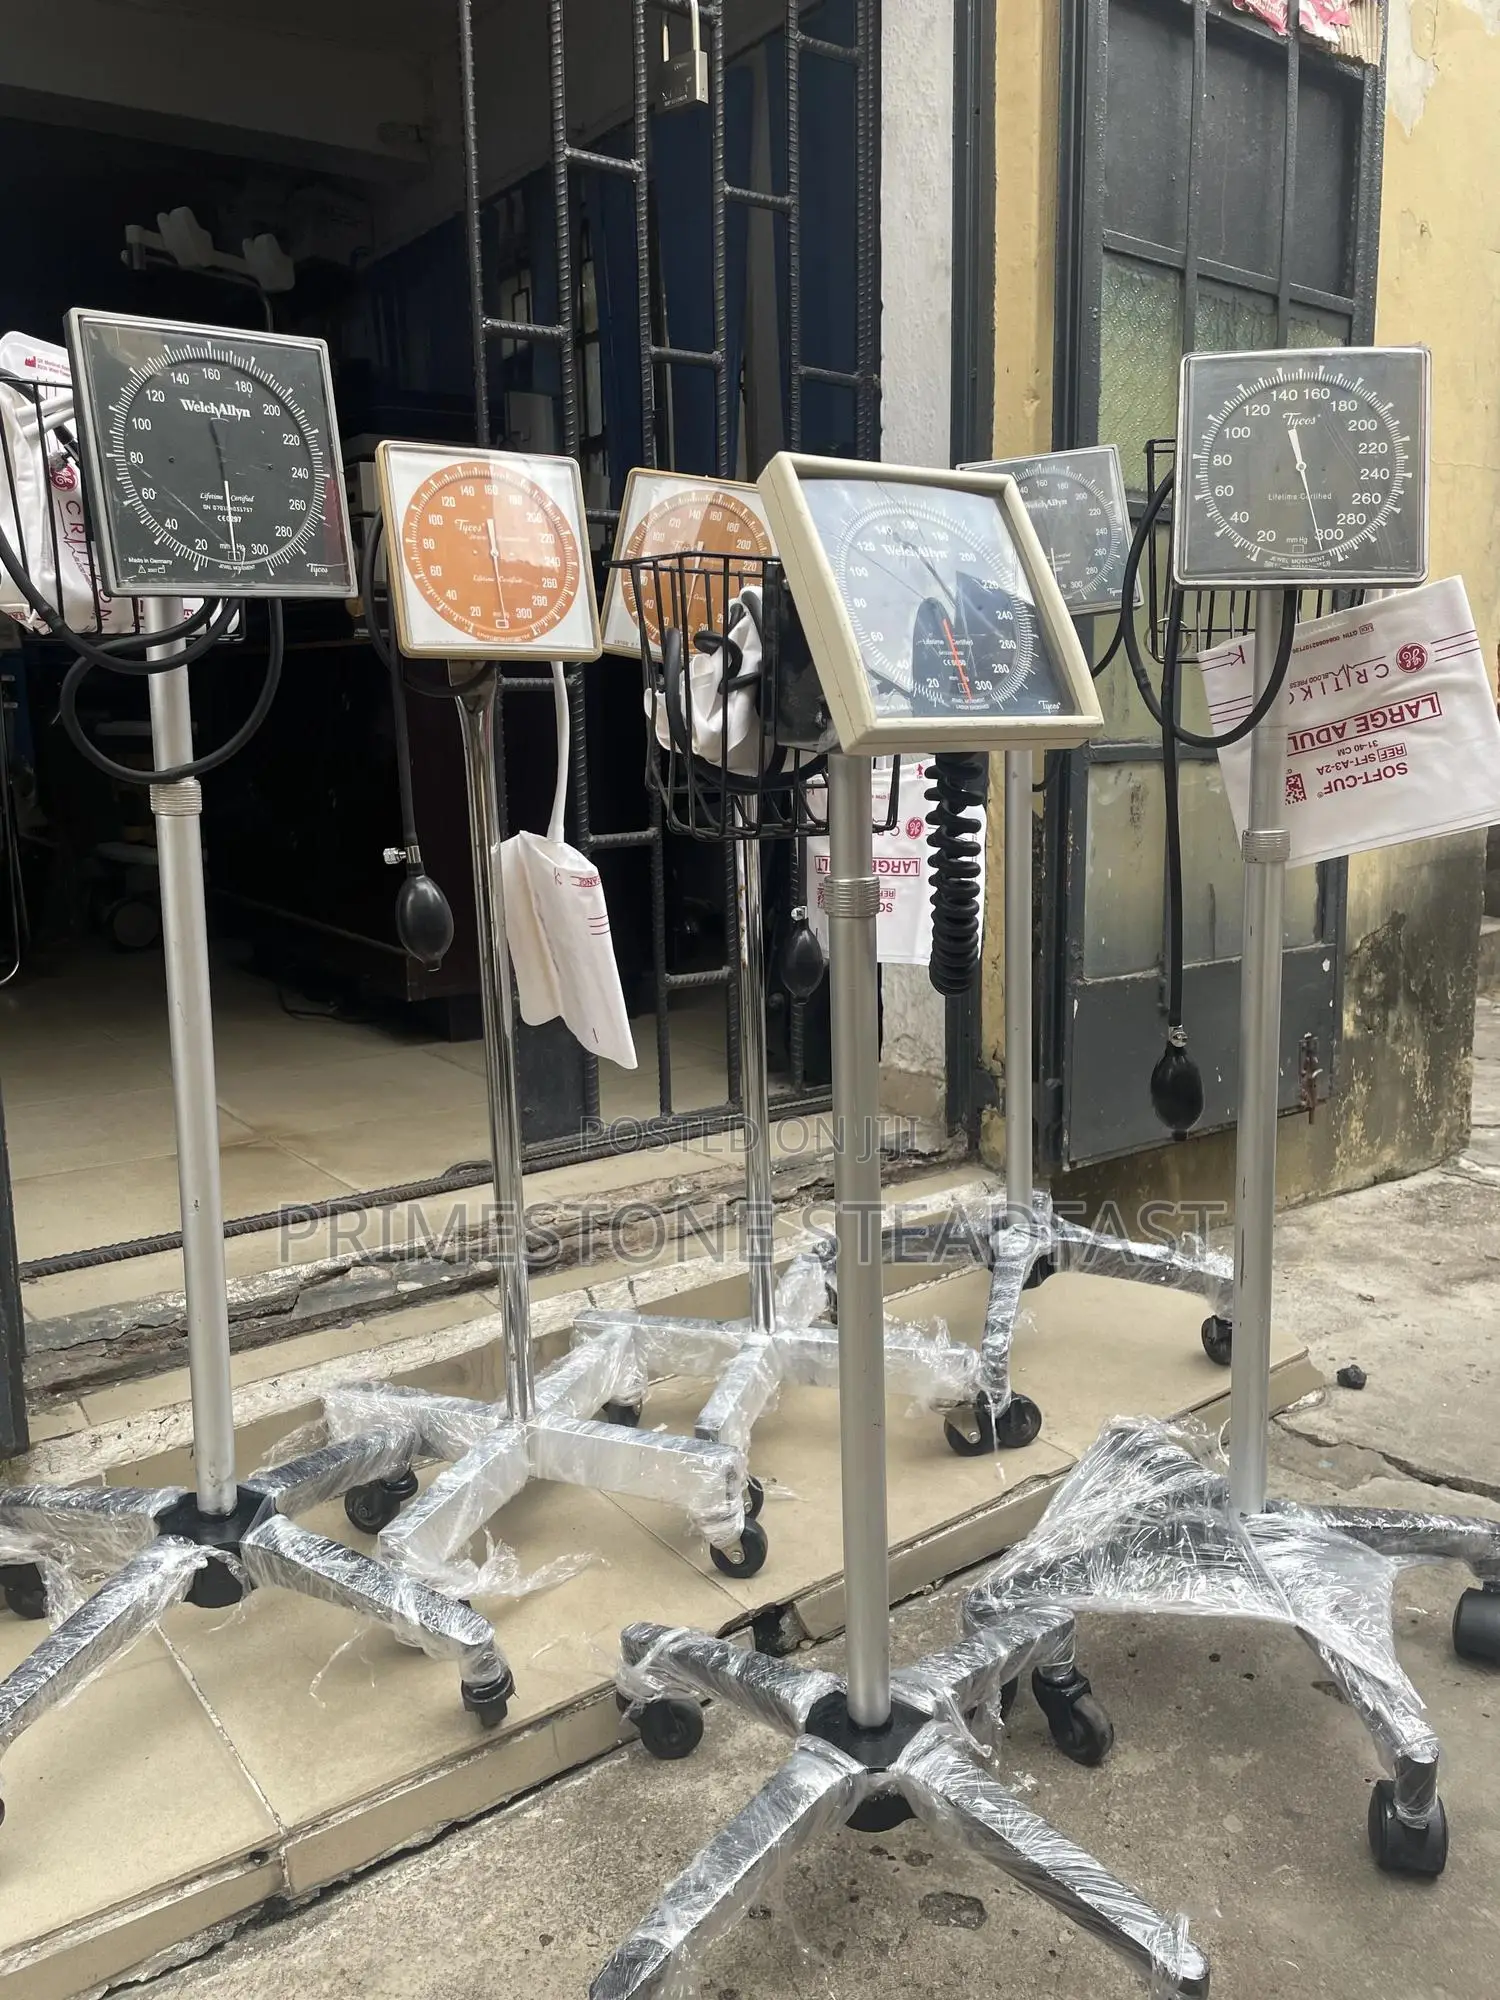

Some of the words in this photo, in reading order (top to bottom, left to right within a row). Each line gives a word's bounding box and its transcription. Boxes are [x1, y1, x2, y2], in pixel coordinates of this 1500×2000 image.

[171, 372, 189, 385] 140
[202, 367, 220, 381] 160
[235, 380, 253, 393] 180
[146, 389, 165, 402] 120
[1271, 389, 1298, 401] 140
[1303, 388, 1330, 400] 160
[180, 398, 251, 421] WelchAllyn
[263, 403, 280, 416] 200
[1243, 404, 1270, 416] 120
[1330, 400, 1358, 412] 180
[132, 417, 152, 431] 100
[1282, 412, 1318, 429] Tycos
[1348, 419, 1378, 432] 200
[1224, 427, 1251, 438] 100
[282, 433, 300, 446] 220
[1358, 442, 1388, 455] 220
[130, 451, 144, 464] 80
[1213, 455, 1233, 466] 80
[291, 466, 309, 479] 240
[1360, 468, 1390, 480] 240
[1036, 479, 1048, 488] 160
[1057, 481, 1068, 490] 180
[142, 487, 155, 500] 60
[460, 485, 475, 496] 140
[484, 484, 498, 496] 160
[1020, 486, 1028, 494] 40
[1215, 486, 1234, 497] 60
[200, 492, 224, 501] Lifetime
[231, 495, 255, 504] Certified
[441, 496, 456, 507] 120
[1074, 492, 1088, 501] 200
[1268, 493, 1297, 501] Lifetime
[1352, 492, 1381, 505] 260
[288, 499, 306, 511] 260
[689, 508, 700, 519] 140
[710, 511, 722, 521] 160
[1088, 508, 1101, 516] 220
[1229, 512, 1249, 523] 40
[428, 514, 443, 526] 100
[526, 512, 542, 524] 200
[668, 518, 681, 528] 120
[1337, 513, 1366, 525] 280
[164, 518, 178, 530] 40
[454, 519, 482, 535] Tycos
[727, 522, 739, 533] 180
[901, 520, 918, 530] 160
[274, 525, 293, 537] 280
[874, 525, 893, 536] 140
[1096, 527, 1108, 536] 240
[1257, 530, 1276, 542] 20
[1314, 529, 1344, 541] 300
[540, 533, 555, 545] 220
[653, 531, 665, 542] 100
[932, 532, 949, 542] 180
[1299, 536, 1308, 545] Hg
[194, 538, 208, 551] 20
[251, 543, 269, 555] 300
[423, 539, 435, 549] 80
[736, 539, 752, 550] 200
[857, 541, 876, 552] 120
[959, 552, 977, 562] 200
[1094, 548, 1107, 556] 260
[544, 556, 560, 567] 240
[1291, 556, 1325, 564] MOVEMENT
[306, 563, 328, 576] Tycos
[430, 565, 442, 576] 60
[742, 561, 757, 572] 220
[850, 567, 869, 577] 100
[1085, 567, 1099, 575] 280
[542, 577, 558, 589] 260
[981, 580, 999, 590] 220
[446, 589, 457, 601] 40
[531, 595, 548, 606] 280
[645, 600, 654, 609] 40
[854, 597, 867, 608] 80
[470, 606, 481, 617] 20
[516, 607, 532, 619] 300
[996, 611, 1014, 621] 240
[871, 631, 884, 642] 60
[1343, 630, 1358, 638] GTIN
[999, 640, 1016, 650] 260
[897, 659, 909, 670] 40
[992, 664, 1010, 674] 280
[926, 678, 940, 688] 20
[1308, 671, 1330, 685] BLOOD
[974, 680, 993, 691] 300
[1038, 700, 1061, 713] Tycos
[1356, 695, 1437, 734] LARGE
[1288, 721, 1347, 751] ADUL
[1337, 746, 1352, 756] CM
[1354, 739, 1378, 753] 31-40
[1382, 745, 1404, 759] REF
[1316, 753, 1377, 775] SFT-A3-2A
